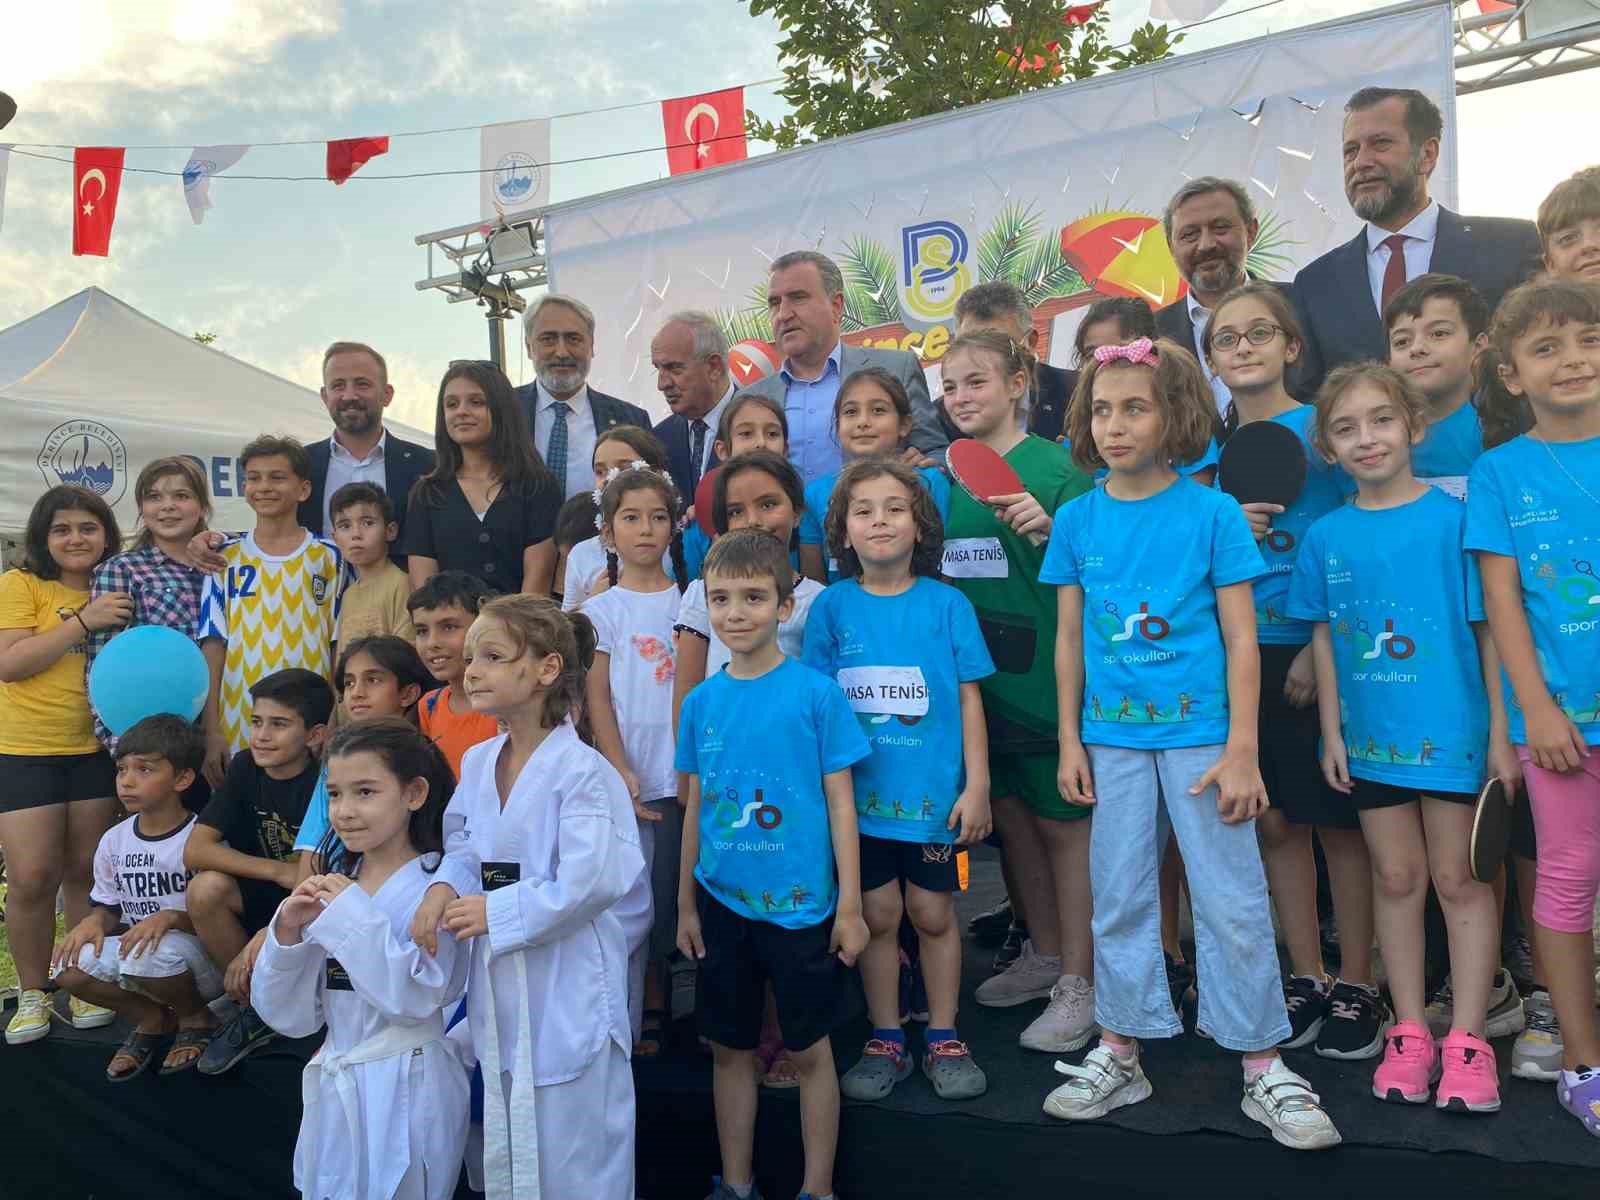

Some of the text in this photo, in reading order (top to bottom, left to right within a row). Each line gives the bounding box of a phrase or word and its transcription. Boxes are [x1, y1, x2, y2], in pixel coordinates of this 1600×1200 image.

[945, 549, 970, 562] MASA
[1559, 620, 1599, 636] spor
[842, 685, 875, 700] MASA
[125, 854, 156, 868] OCEAN
[123, 871, 189, 898] TRENC
